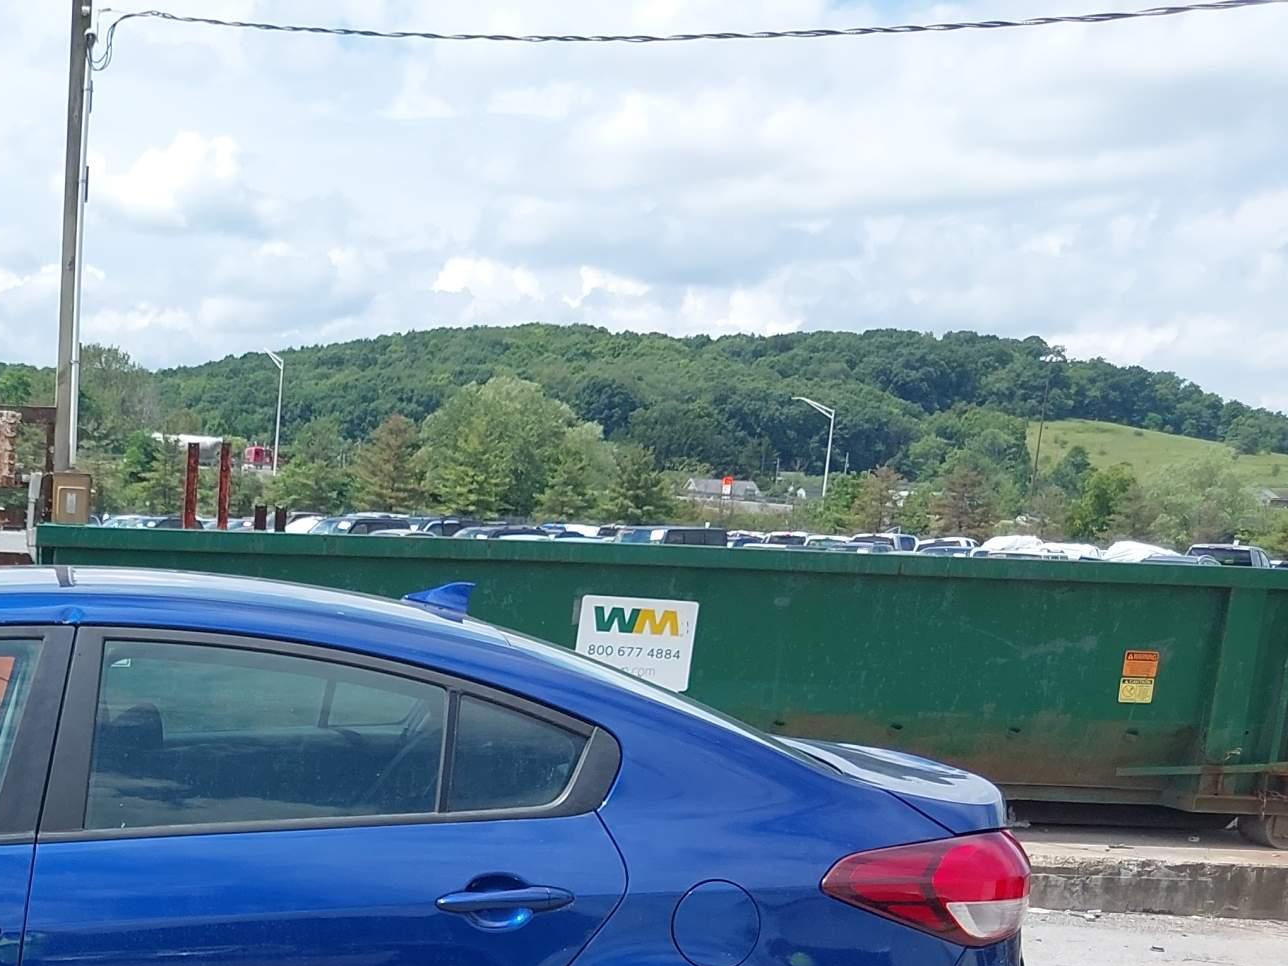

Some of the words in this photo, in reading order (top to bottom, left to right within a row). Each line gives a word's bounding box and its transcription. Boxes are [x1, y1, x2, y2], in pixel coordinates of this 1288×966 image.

[594, 606, 679, 636] WM
[587, 644, 614, 656] 800
[617, 646, 643, 658] 677
[647, 648, 681, 660] 4884
